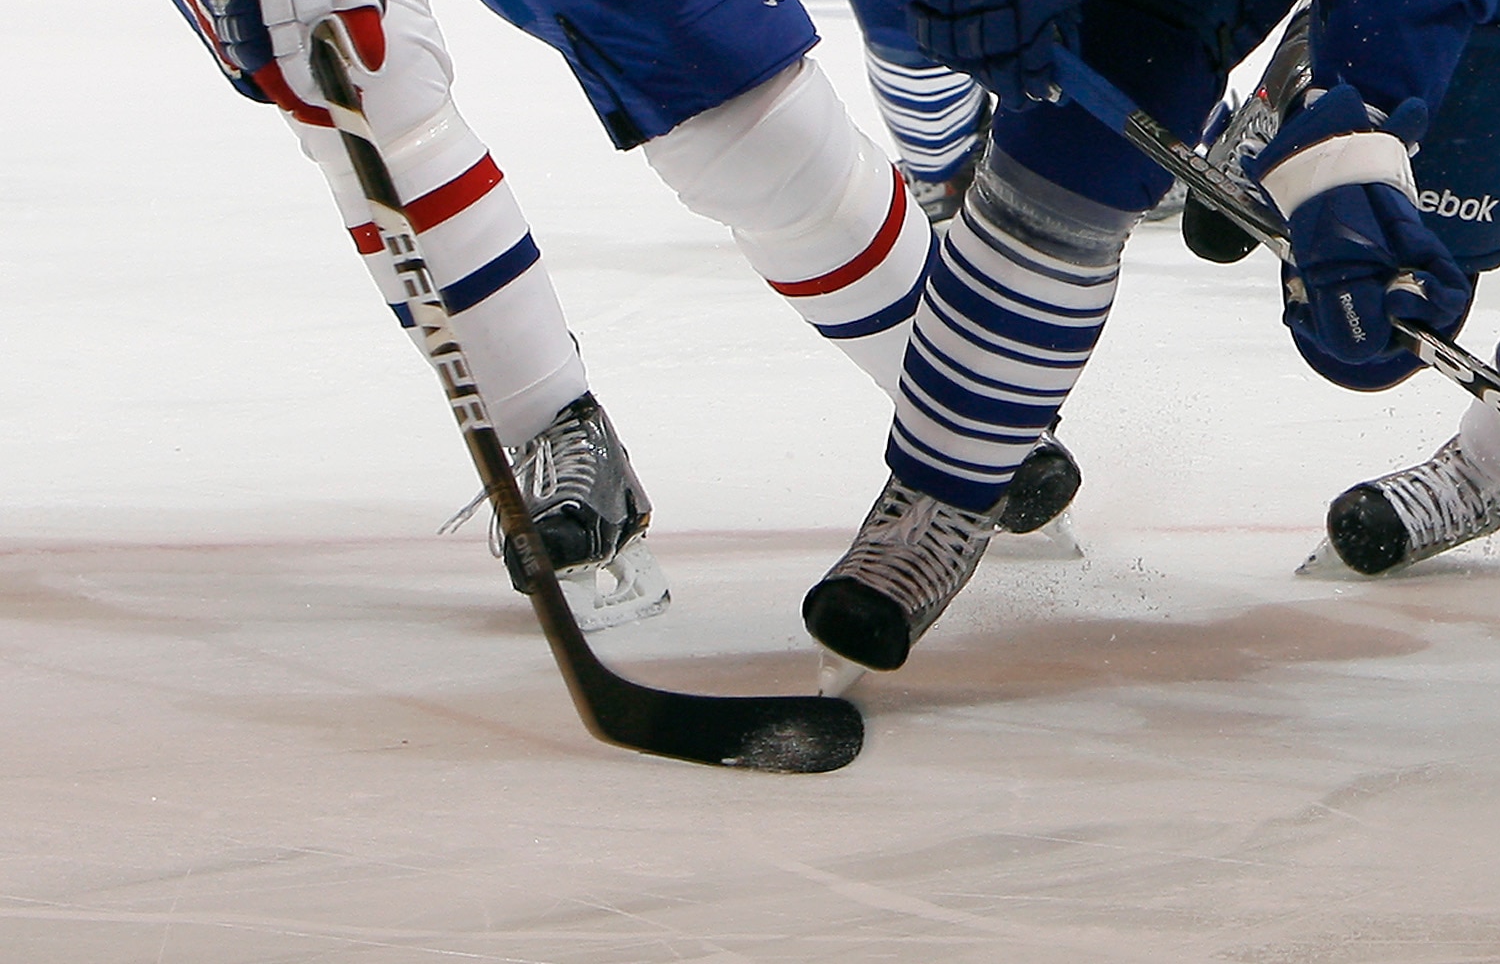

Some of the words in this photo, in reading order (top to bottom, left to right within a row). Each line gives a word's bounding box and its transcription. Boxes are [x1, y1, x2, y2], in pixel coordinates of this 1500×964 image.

[1418, 189, 1500, 224] ebok
[1338, 292, 1367, 344] Reebok
[513, 531, 543, 577] ONE
